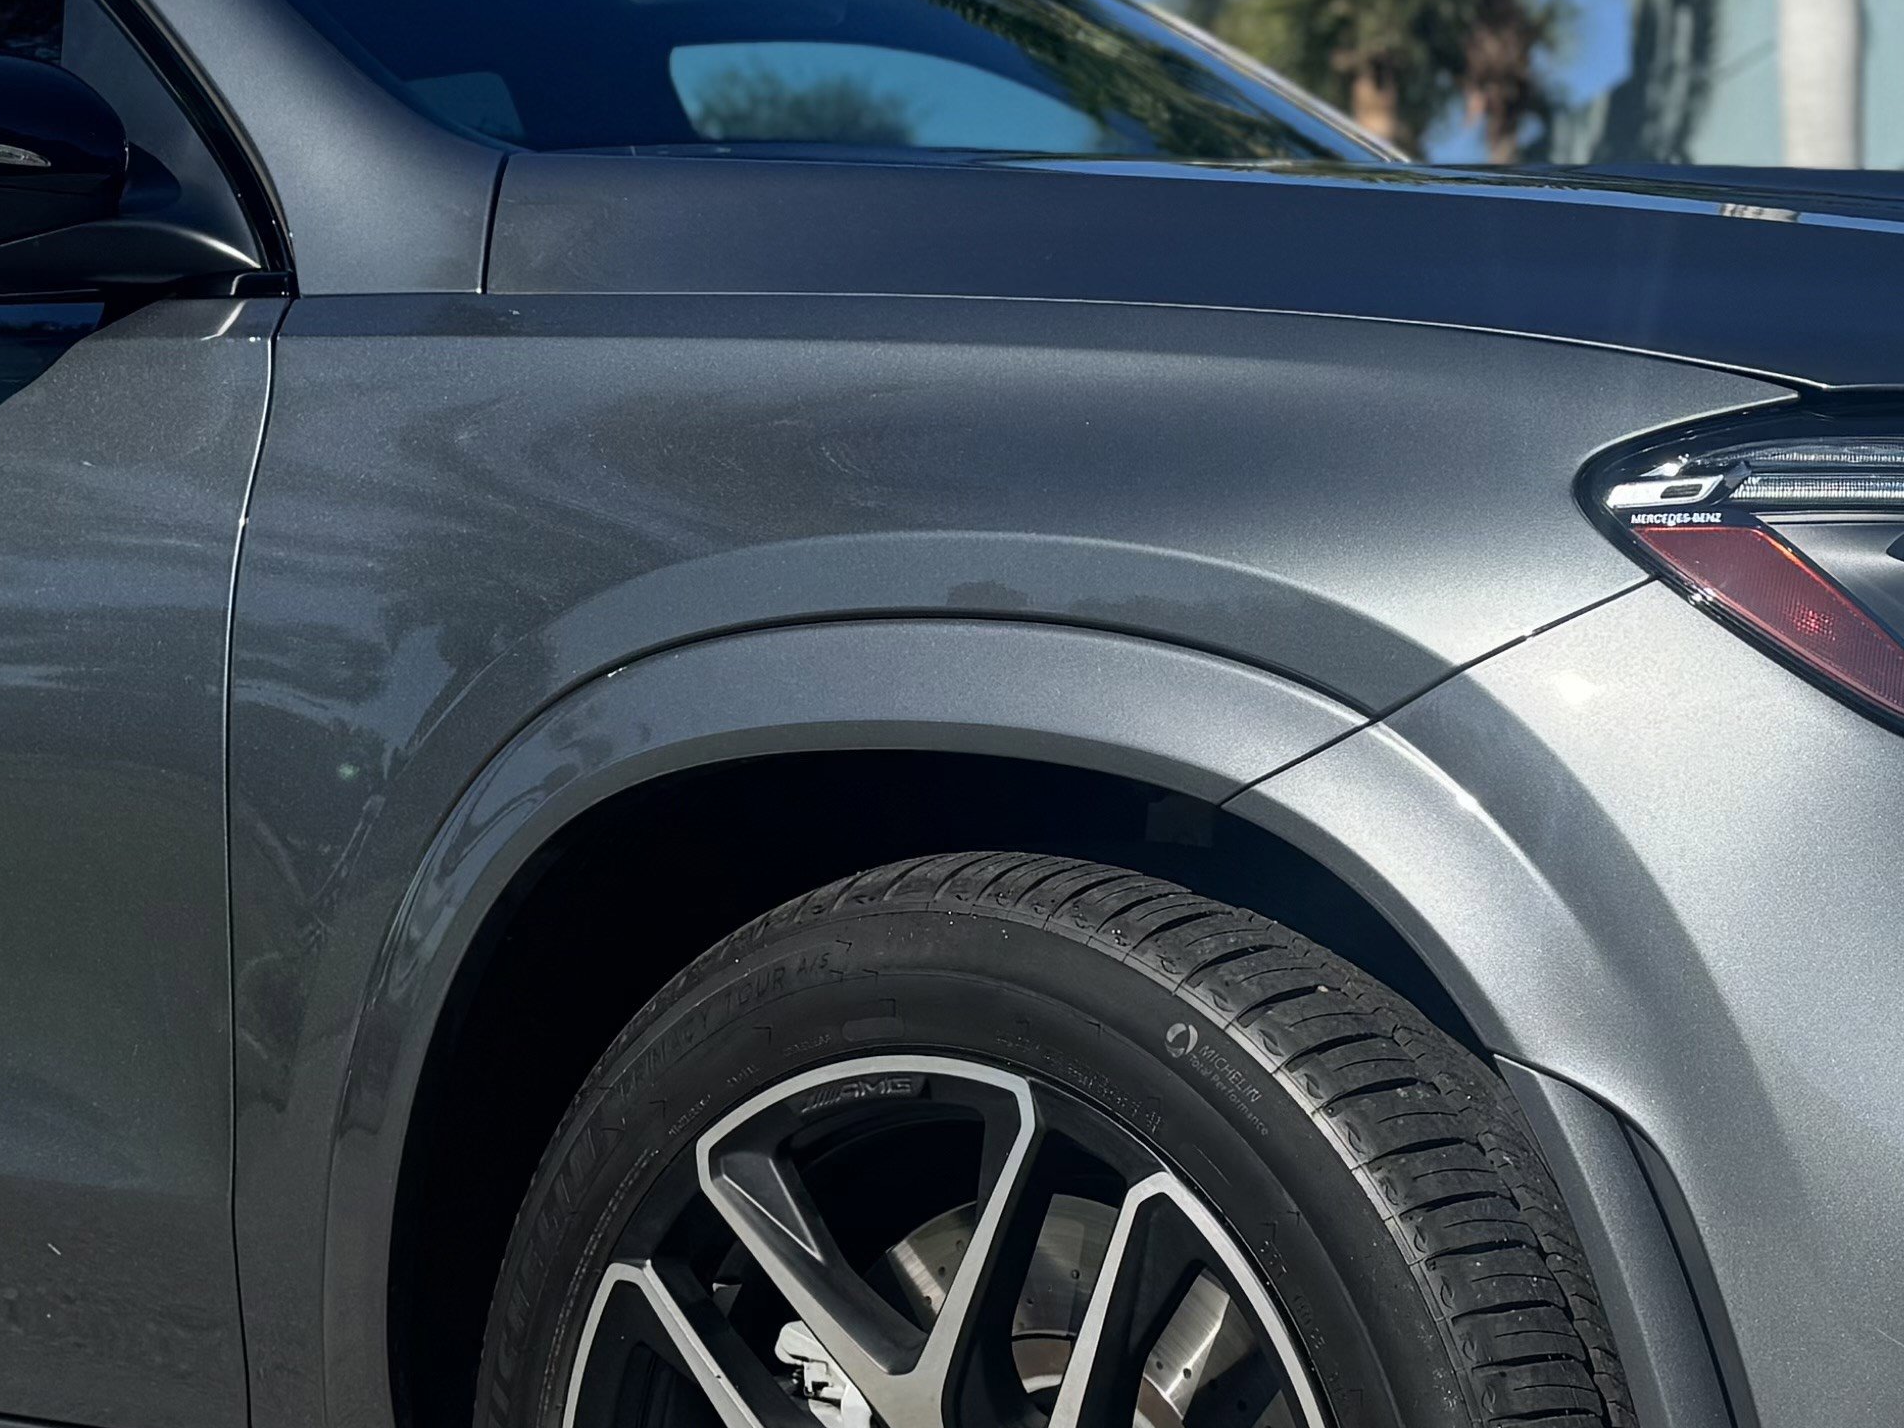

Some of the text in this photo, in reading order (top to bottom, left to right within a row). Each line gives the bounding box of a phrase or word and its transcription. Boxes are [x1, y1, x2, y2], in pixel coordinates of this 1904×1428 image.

[1629, 511, 1723, 526] MERCEDES-BENZ
[723, 965, 787, 1011] TOUR
[839, 1075, 914, 1102] AMG
[1198, 1044, 1263, 1103] MICHELIN
[1210, 1074, 1269, 1137] Performance
